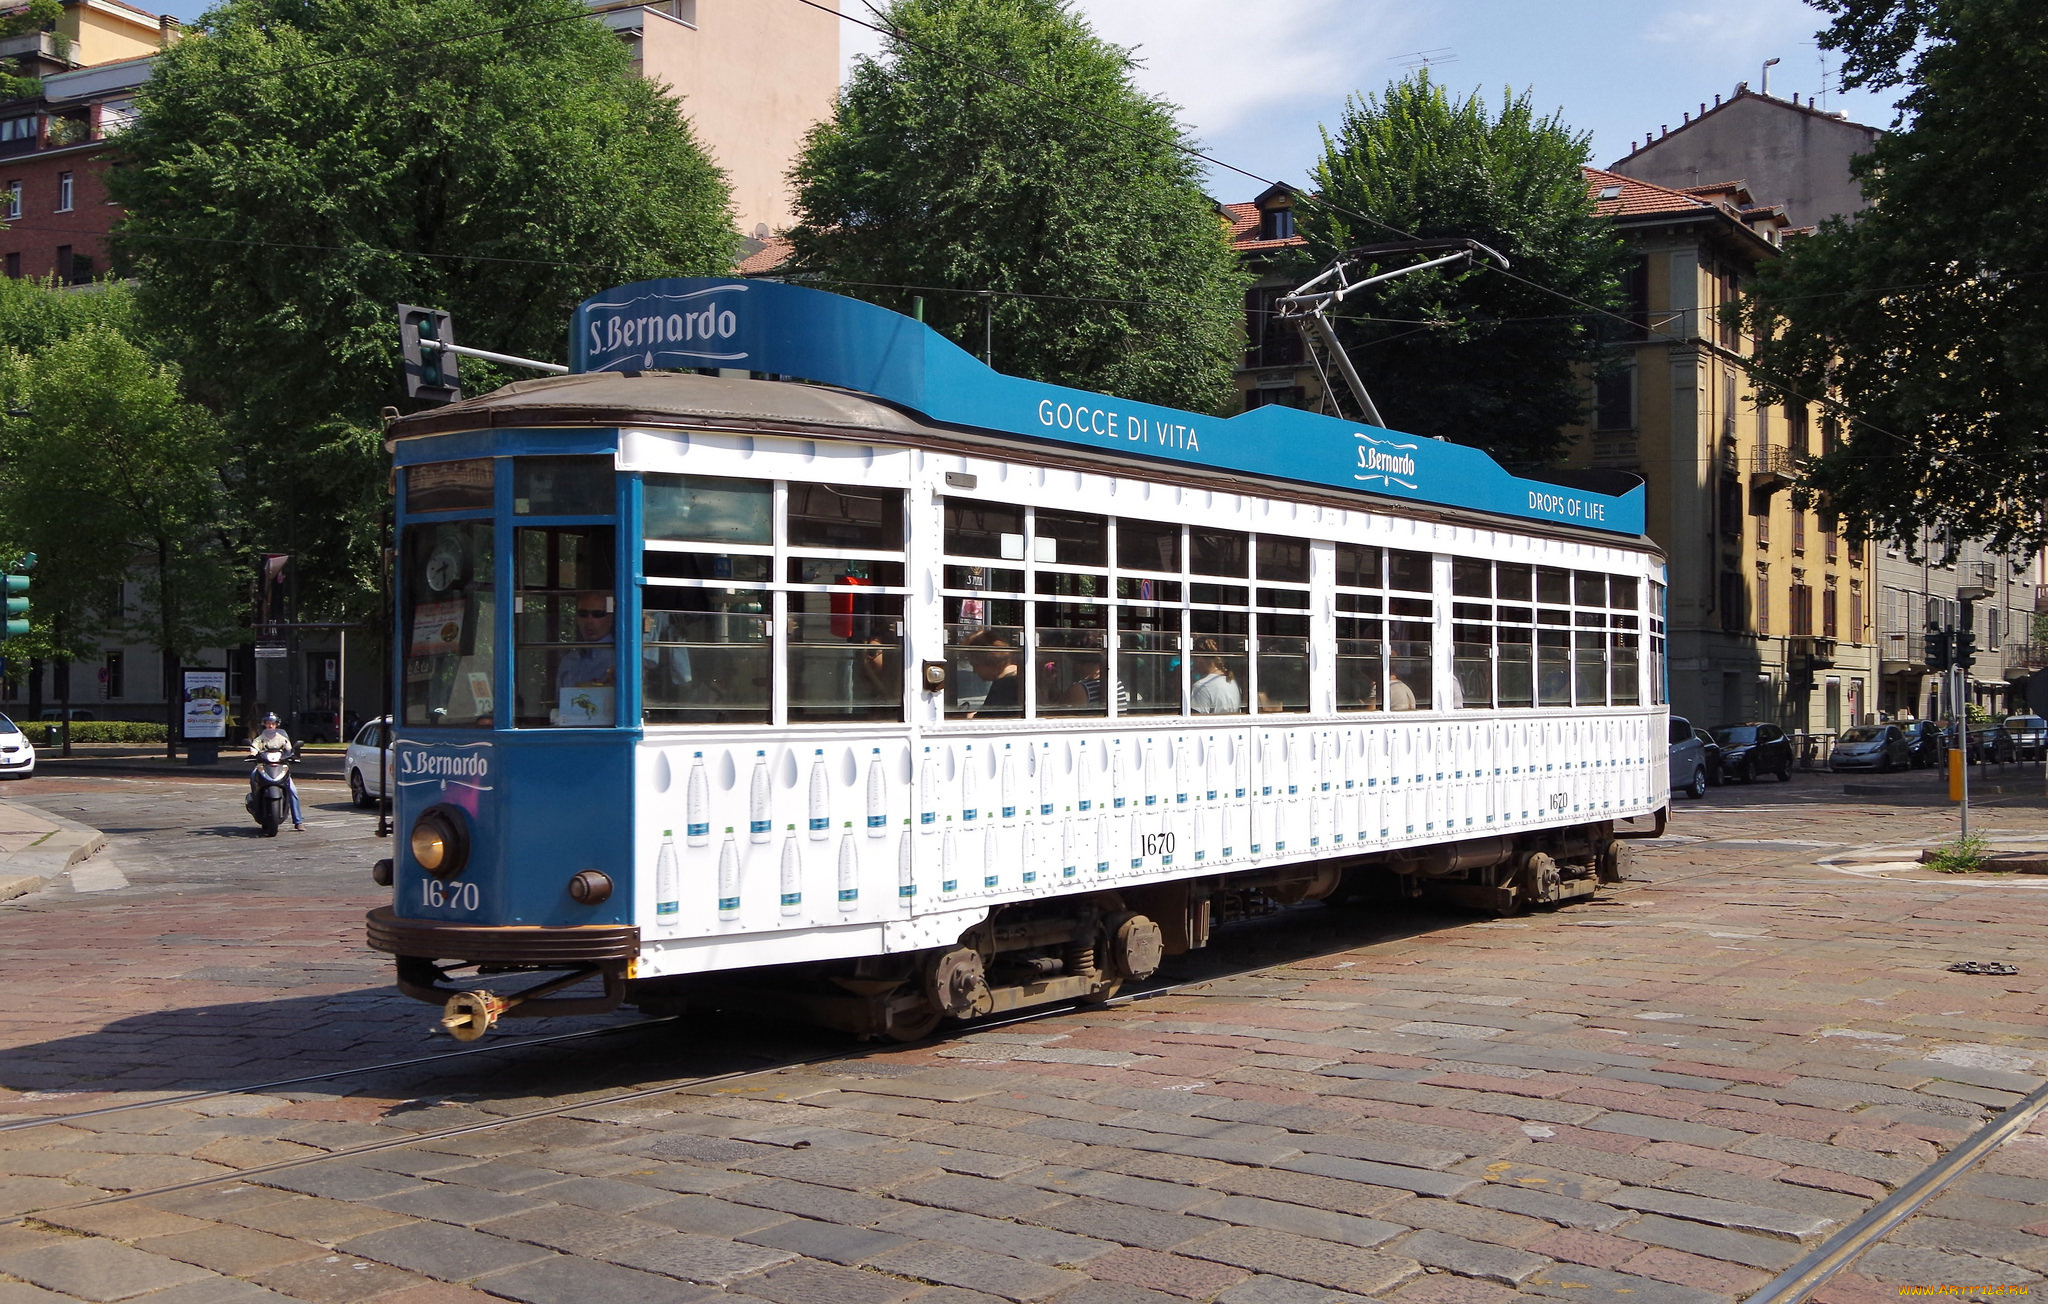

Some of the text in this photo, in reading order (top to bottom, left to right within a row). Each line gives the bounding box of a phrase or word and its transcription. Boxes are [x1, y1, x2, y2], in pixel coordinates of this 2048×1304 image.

[589, 302, 737, 356] S.Bernardo
[1038, 399, 1199, 452] GOCCE DI VITA
[1357, 445, 1415, 476] S.Bernardo
[1528, 491, 1605, 521] DROPS OF LIFE
[401, 751, 488, 776] S.Bernardo
[1550, 791, 1568, 810] 1670
[1140, 831, 1175, 857] 1670
[422, 878, 479, 911] 1670
